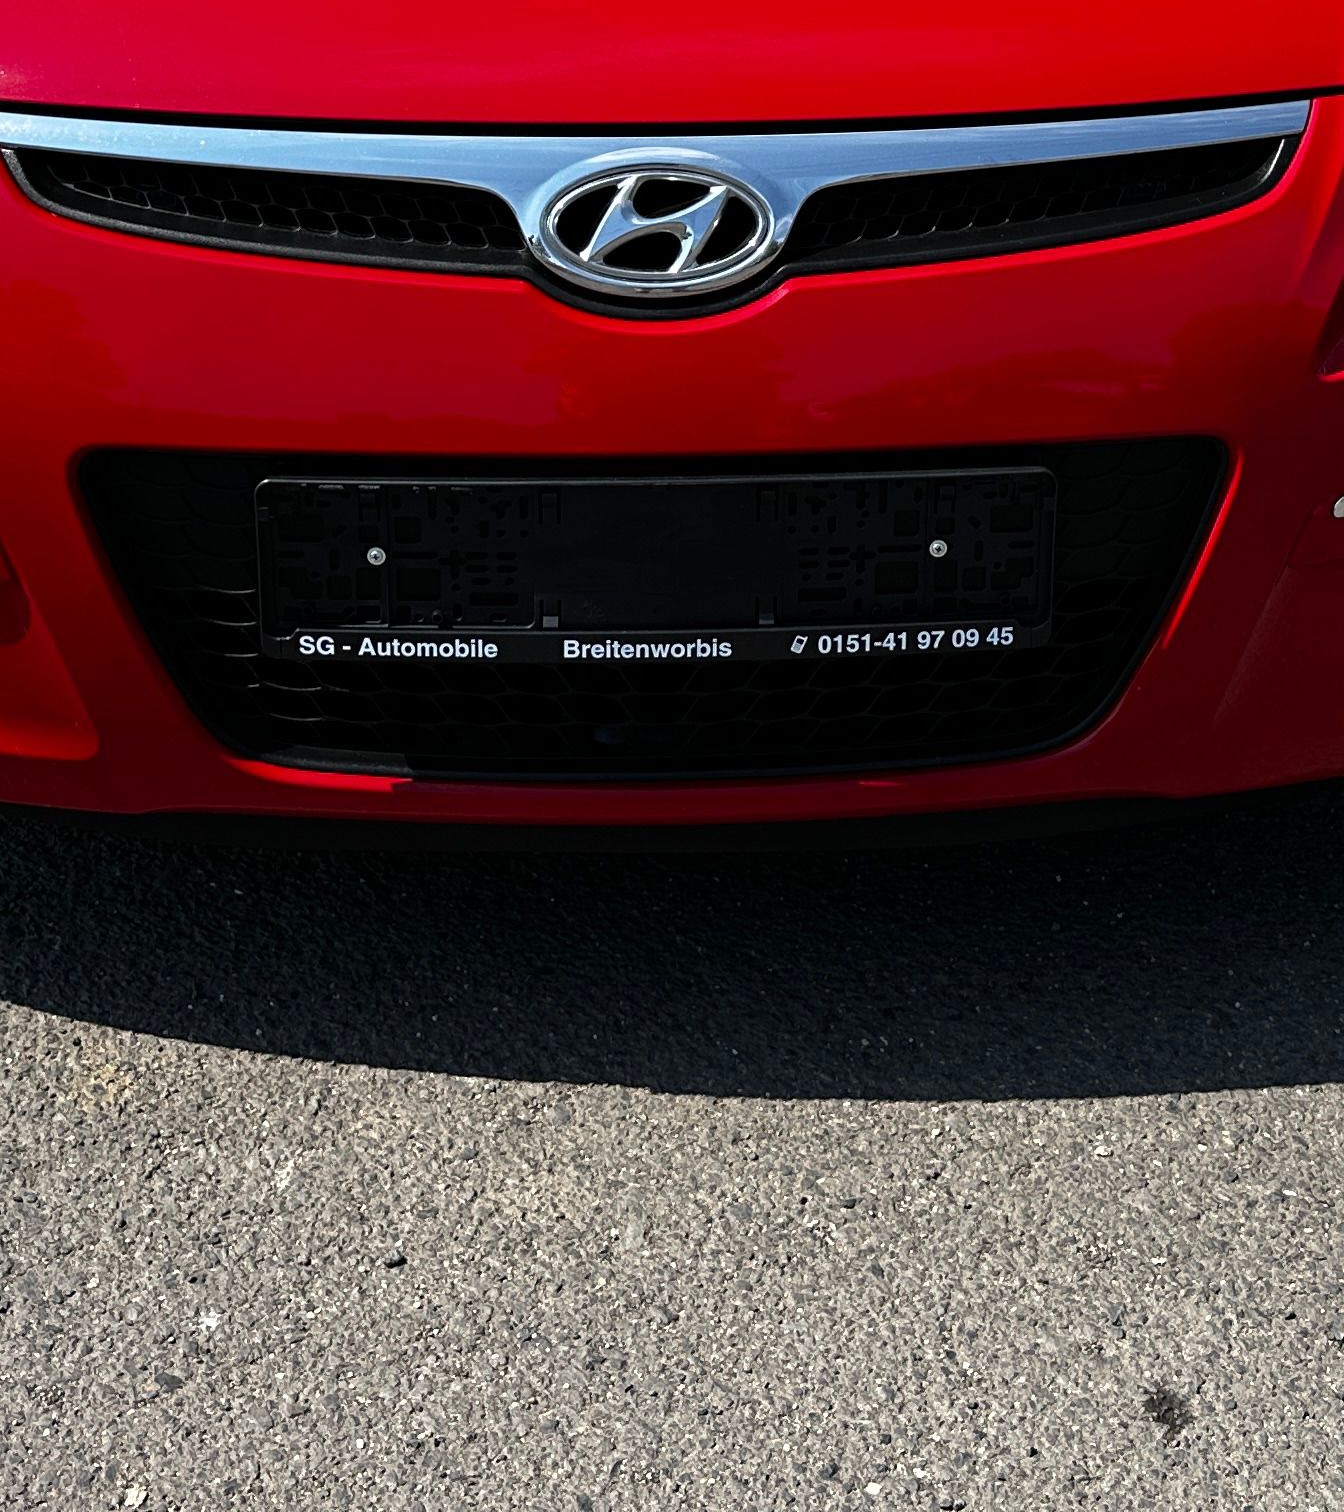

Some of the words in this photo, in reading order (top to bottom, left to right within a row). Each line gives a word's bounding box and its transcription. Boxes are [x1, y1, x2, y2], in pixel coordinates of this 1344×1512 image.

[299, 635, 335, 656] SG
[357, 637, 499, 659] Automobile
[563, 638, 733, 659] Breitenworbis
[817, 631, 907, 654] 0151-41
[917, 630, 945, 650] 97
[951, 628, 980, 648] 09
[986, 626, 1014, 646] 45
